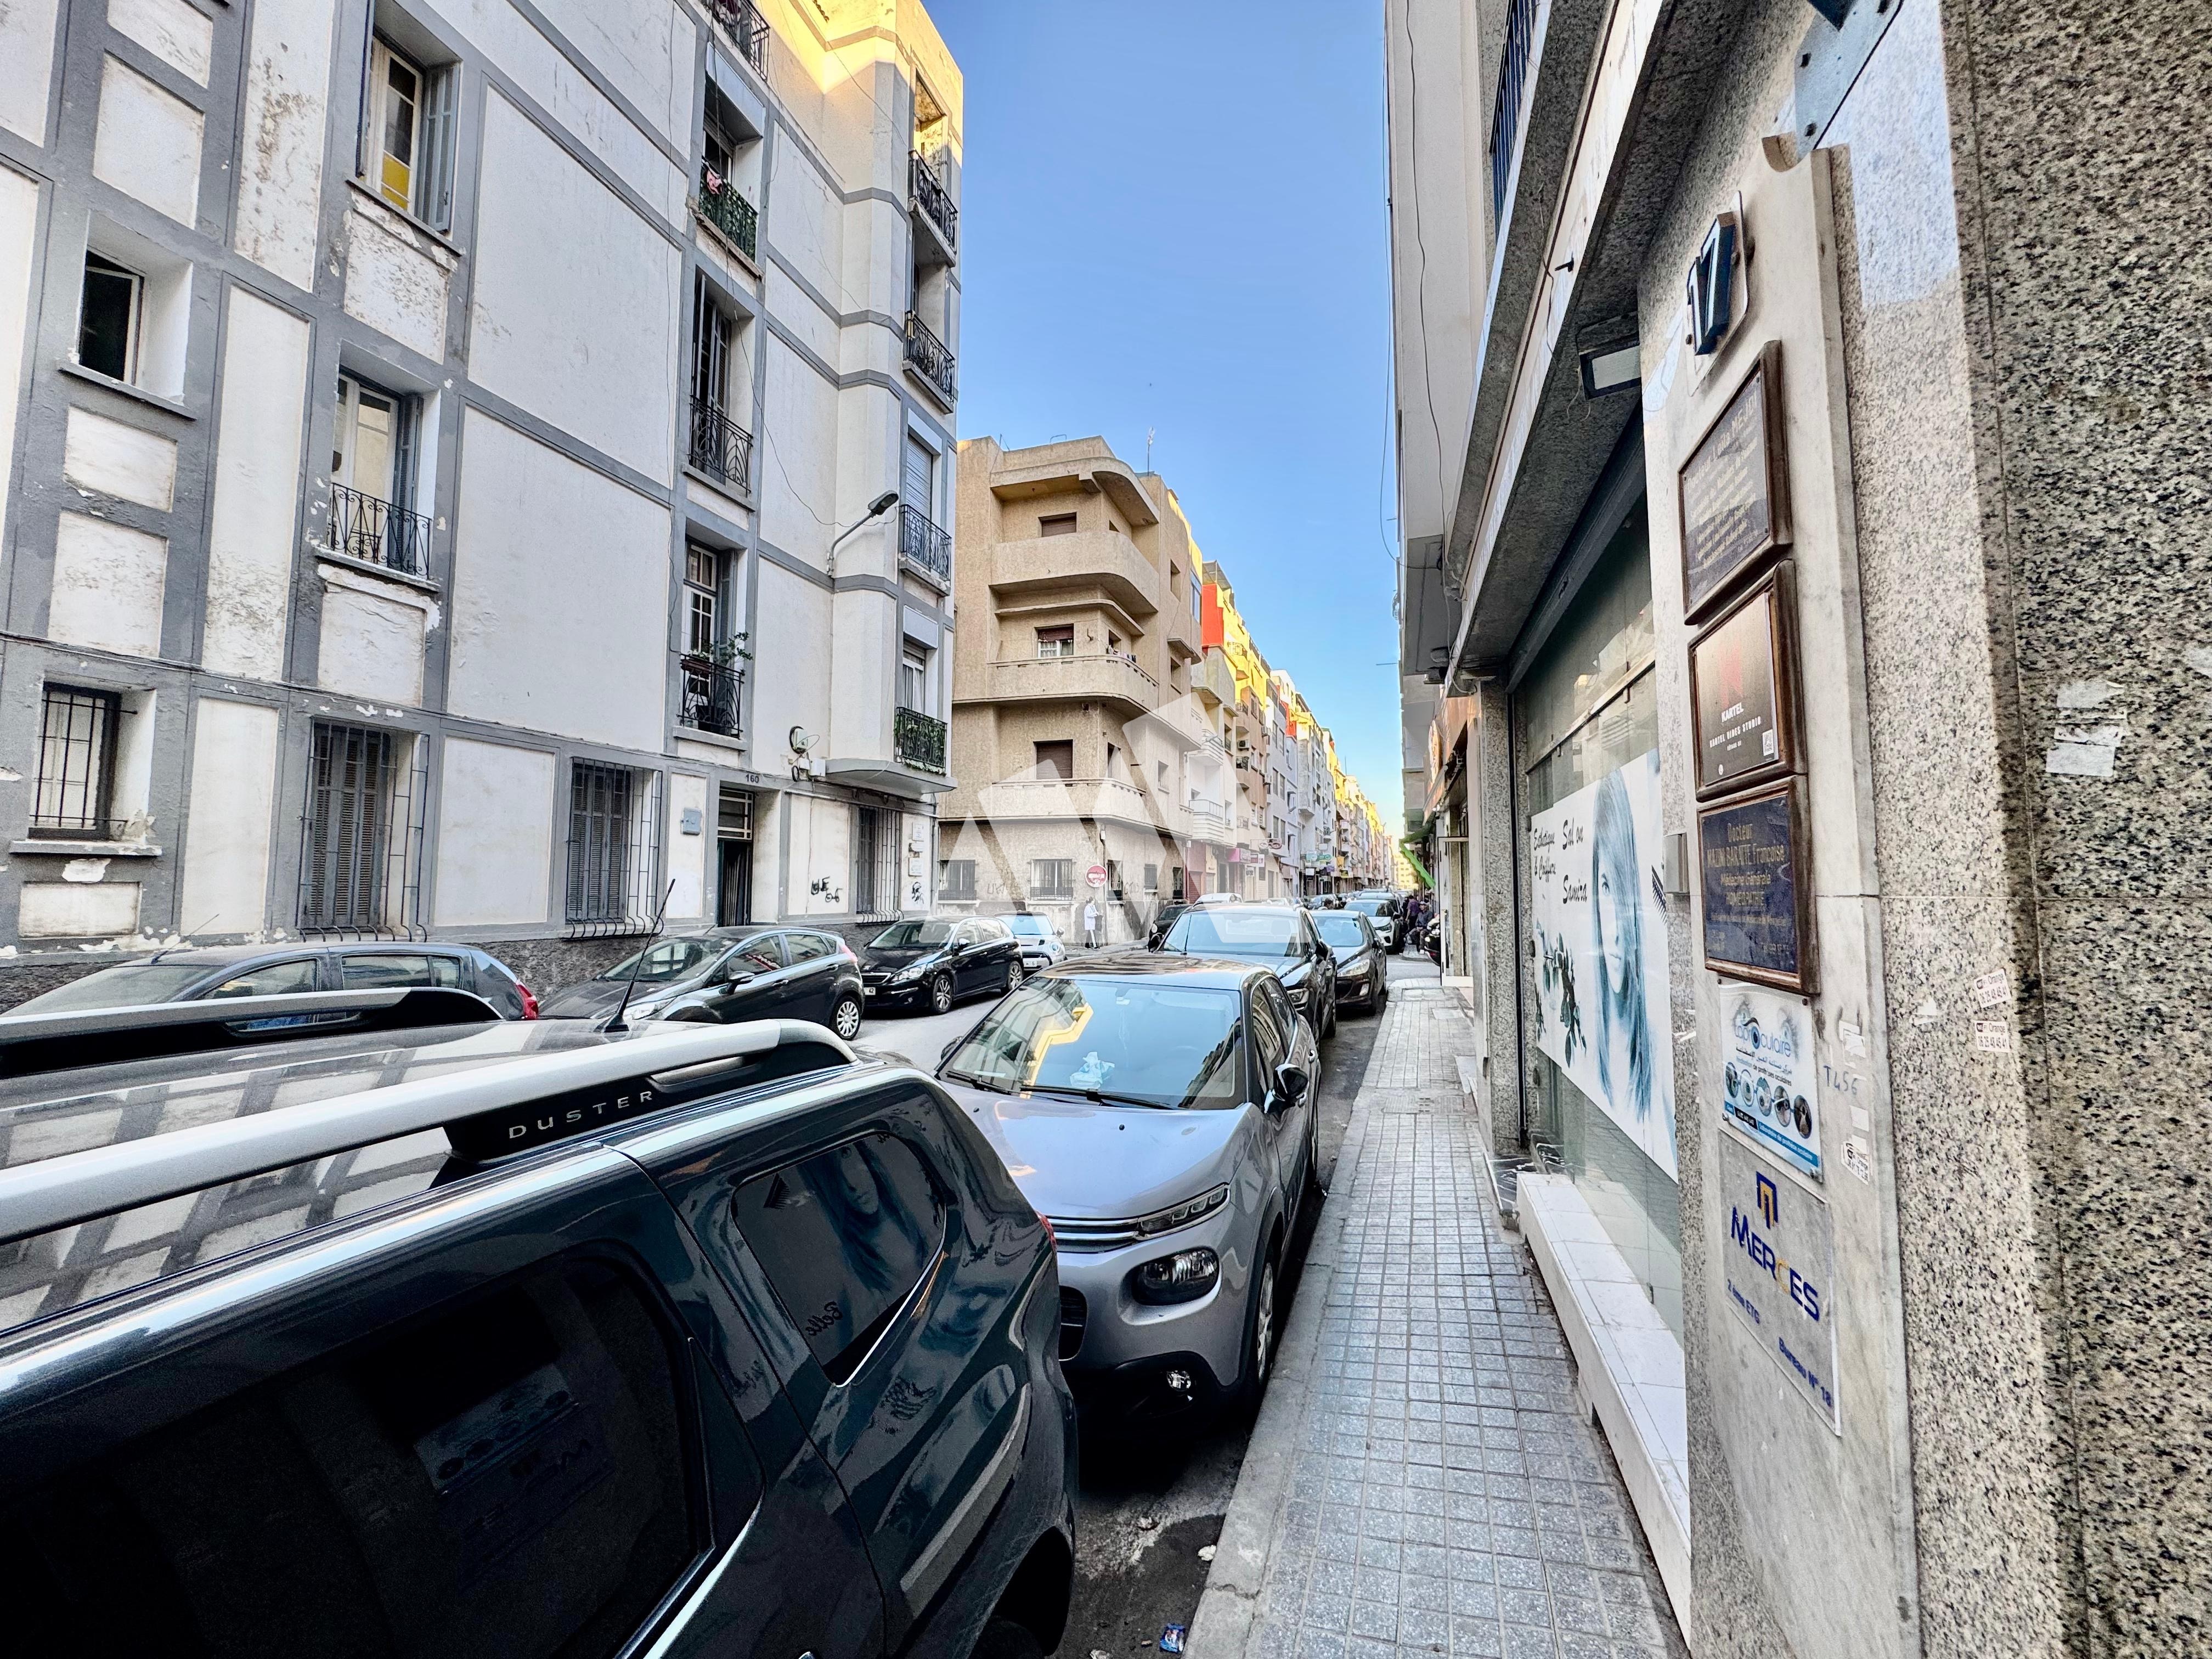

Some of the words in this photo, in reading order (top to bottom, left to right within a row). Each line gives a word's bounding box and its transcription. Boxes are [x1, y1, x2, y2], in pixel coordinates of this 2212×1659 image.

[1721, 702, 1744, 722] KARTEL
[1742, 716, 1761, 732] STUDIO
[746, 774, 759, 783] 160
[1728, 823, 1752, 842] Docteur
[1562, 874, 1587, 904] Samira
[1989, 1023, 2005, 1035] Orange
[508, 1090, 653, 1139] DUSTER
[1731, 1207, 1820, 1322] MERCES
[1728, 1278, 1731, 1291] 2
[1779, 1336, 1807, 1379] Bureau
